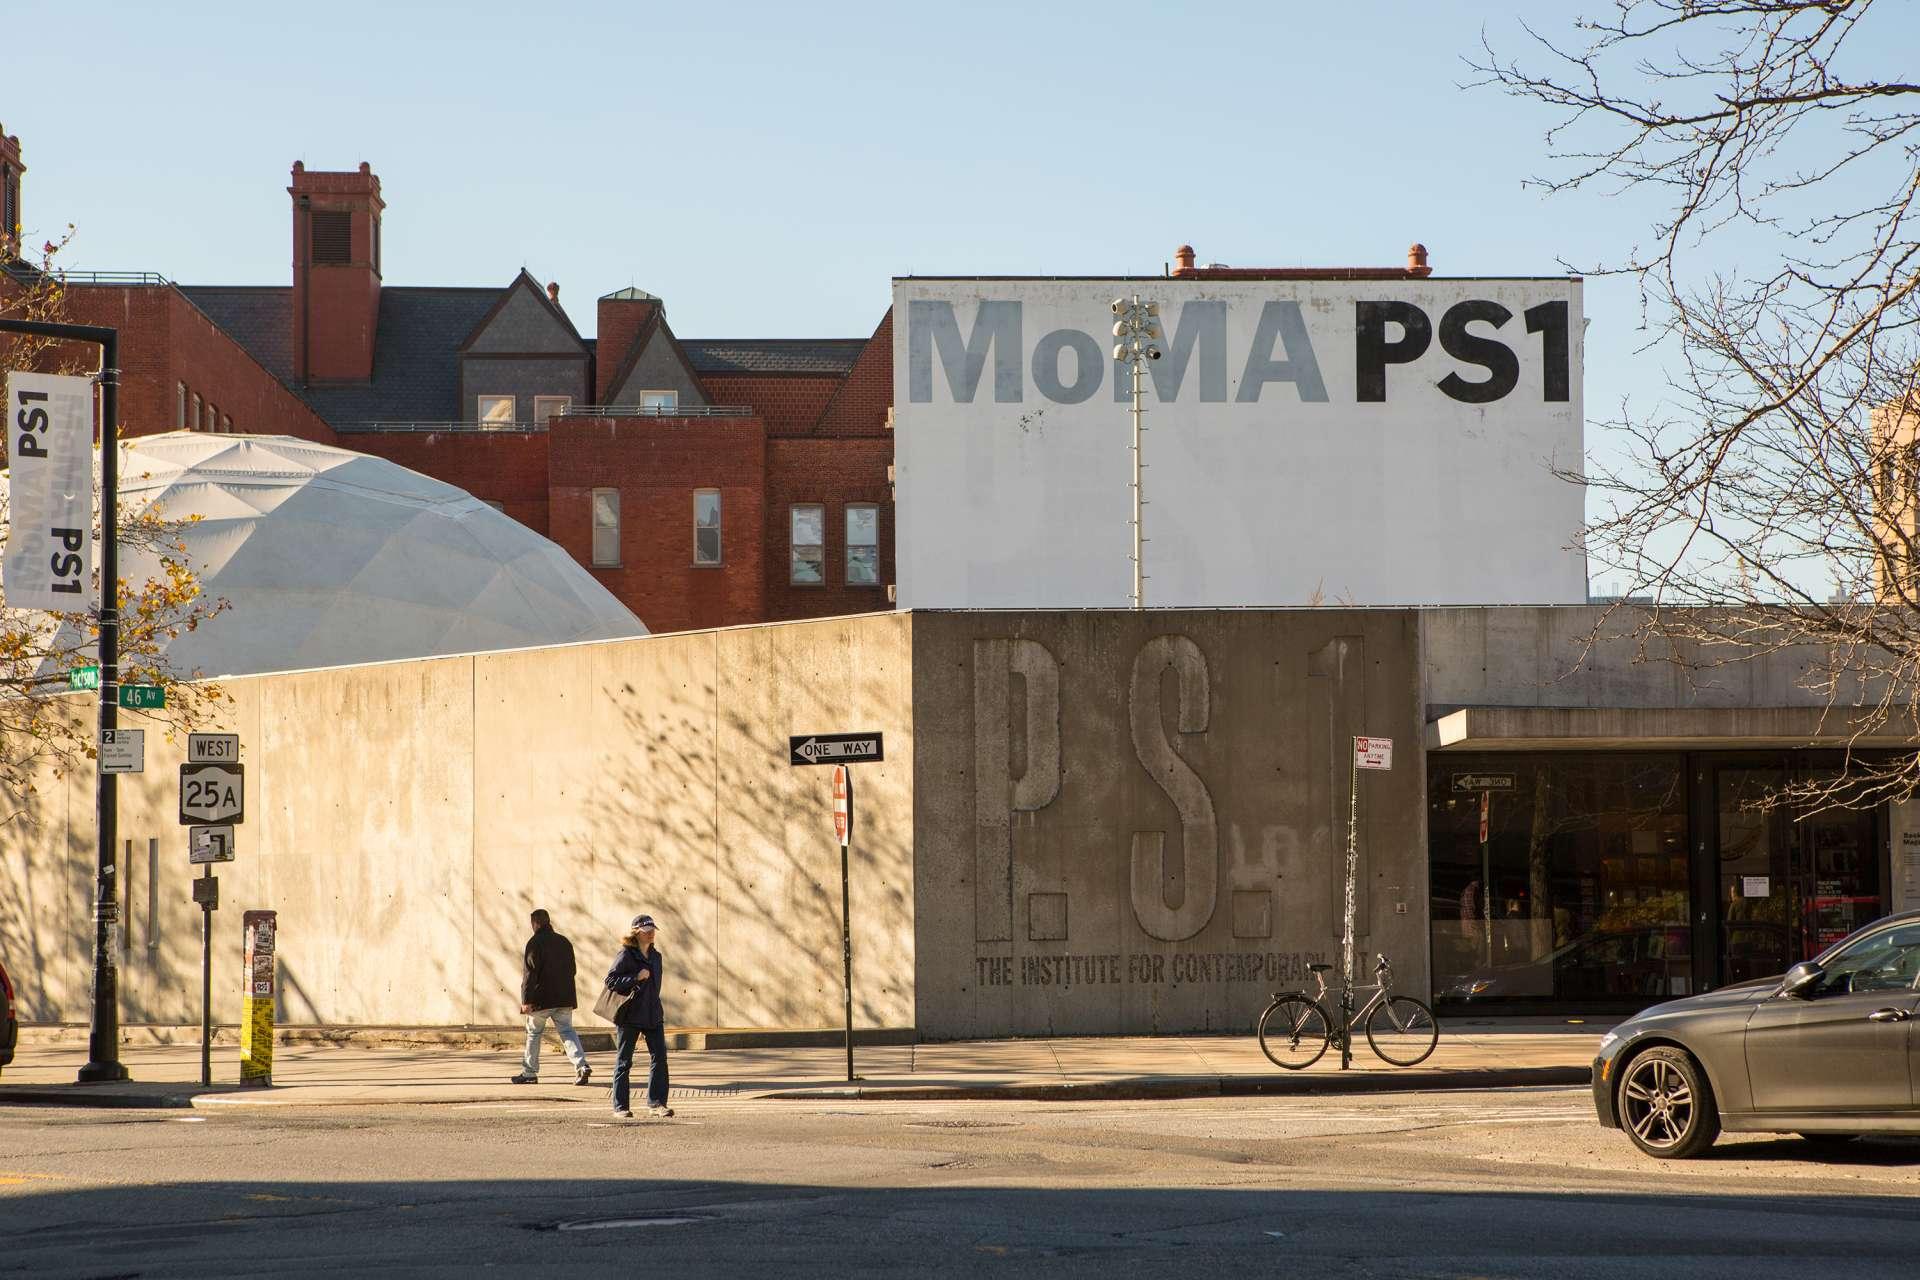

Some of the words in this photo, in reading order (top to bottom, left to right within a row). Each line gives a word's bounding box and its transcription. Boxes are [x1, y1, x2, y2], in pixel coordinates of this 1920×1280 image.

[908, 299, 1330, 405] MoMA
[1355, 299, 1570, 405] PS1
[17, 390, 49, 459] PS1
[51, 527, 84, 594] PS1
[126, 689, 142, 705] 46
[105, 731, 113, 744] 2
[196, 740, 232, 757] WEST
[804, 743, 831, 757] ONE
[843, 741, 871, 755] WAY
[1357, 740, 1368, 750] NO
[186, 780, 237, 809] 25A
[975, 956, 1013, 986] THE
[1022, 955, 1121, 985] INSTITUTE
[1128, 953, 1165, 984] FOR
